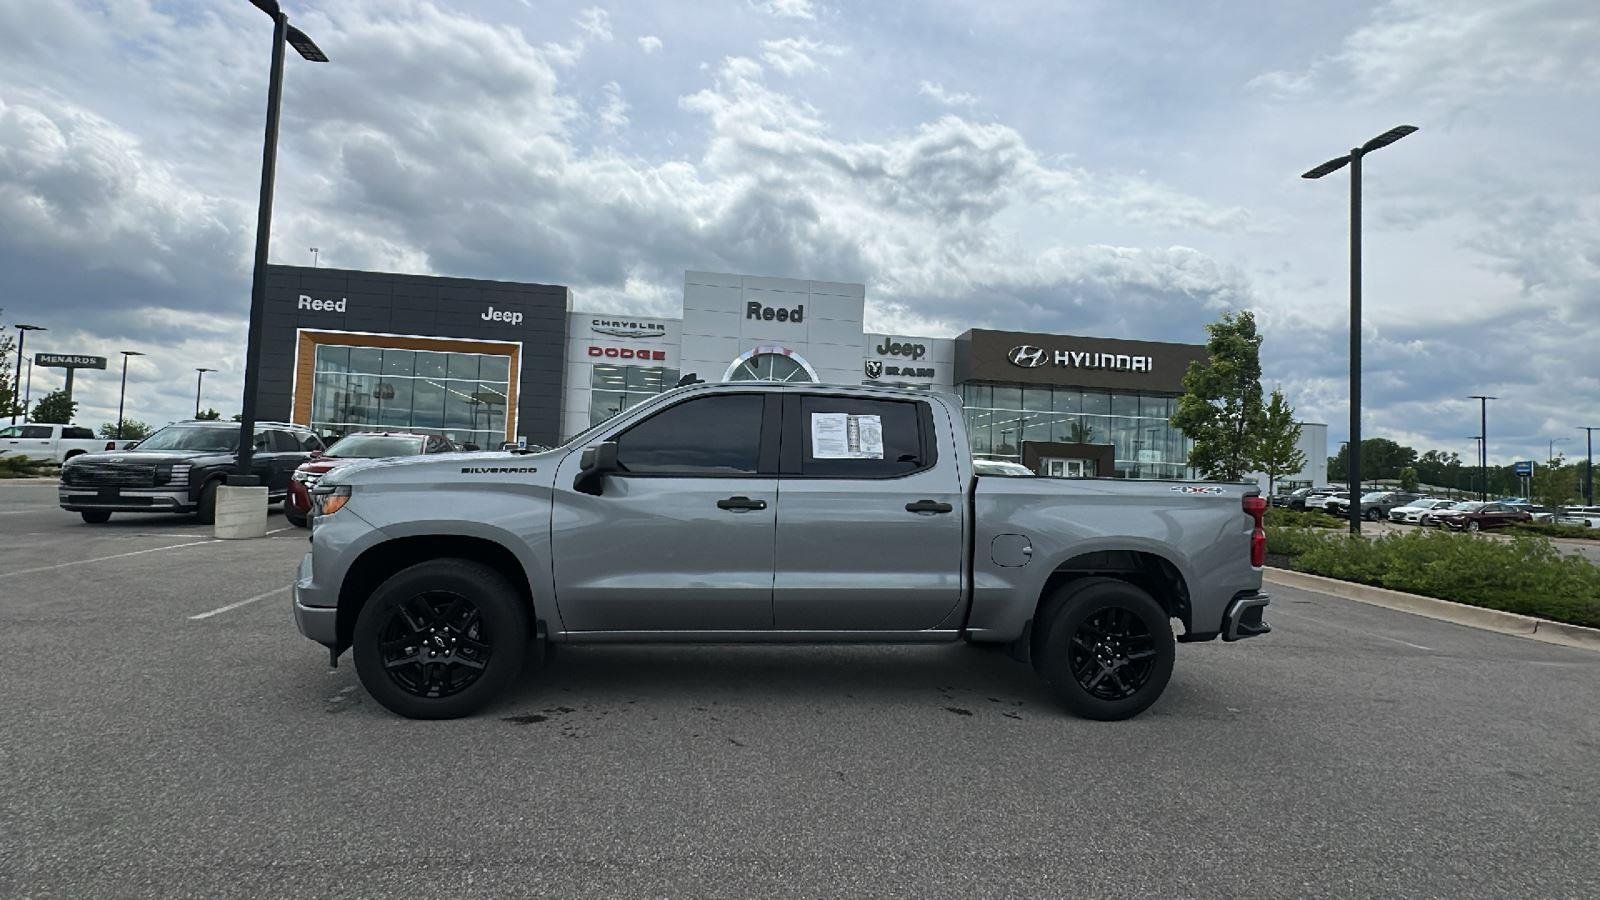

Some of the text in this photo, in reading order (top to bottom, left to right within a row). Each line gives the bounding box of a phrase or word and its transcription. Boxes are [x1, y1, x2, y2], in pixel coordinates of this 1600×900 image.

[298, 294, 347, 313] Reed
[746, 301, 804, 323] Reed
[481, 306, 523, 326] Jeep
[592, 319, 665, 331] CHRYSLER
[588, 346, 666, 361] DODGE
[877, 337, 926, 360] Jeep
[40, 355, 97, 364] MENARDS
[1054, 350, 1153, 371] HYUNDAI
[885, 366, 935, 378] RAM
